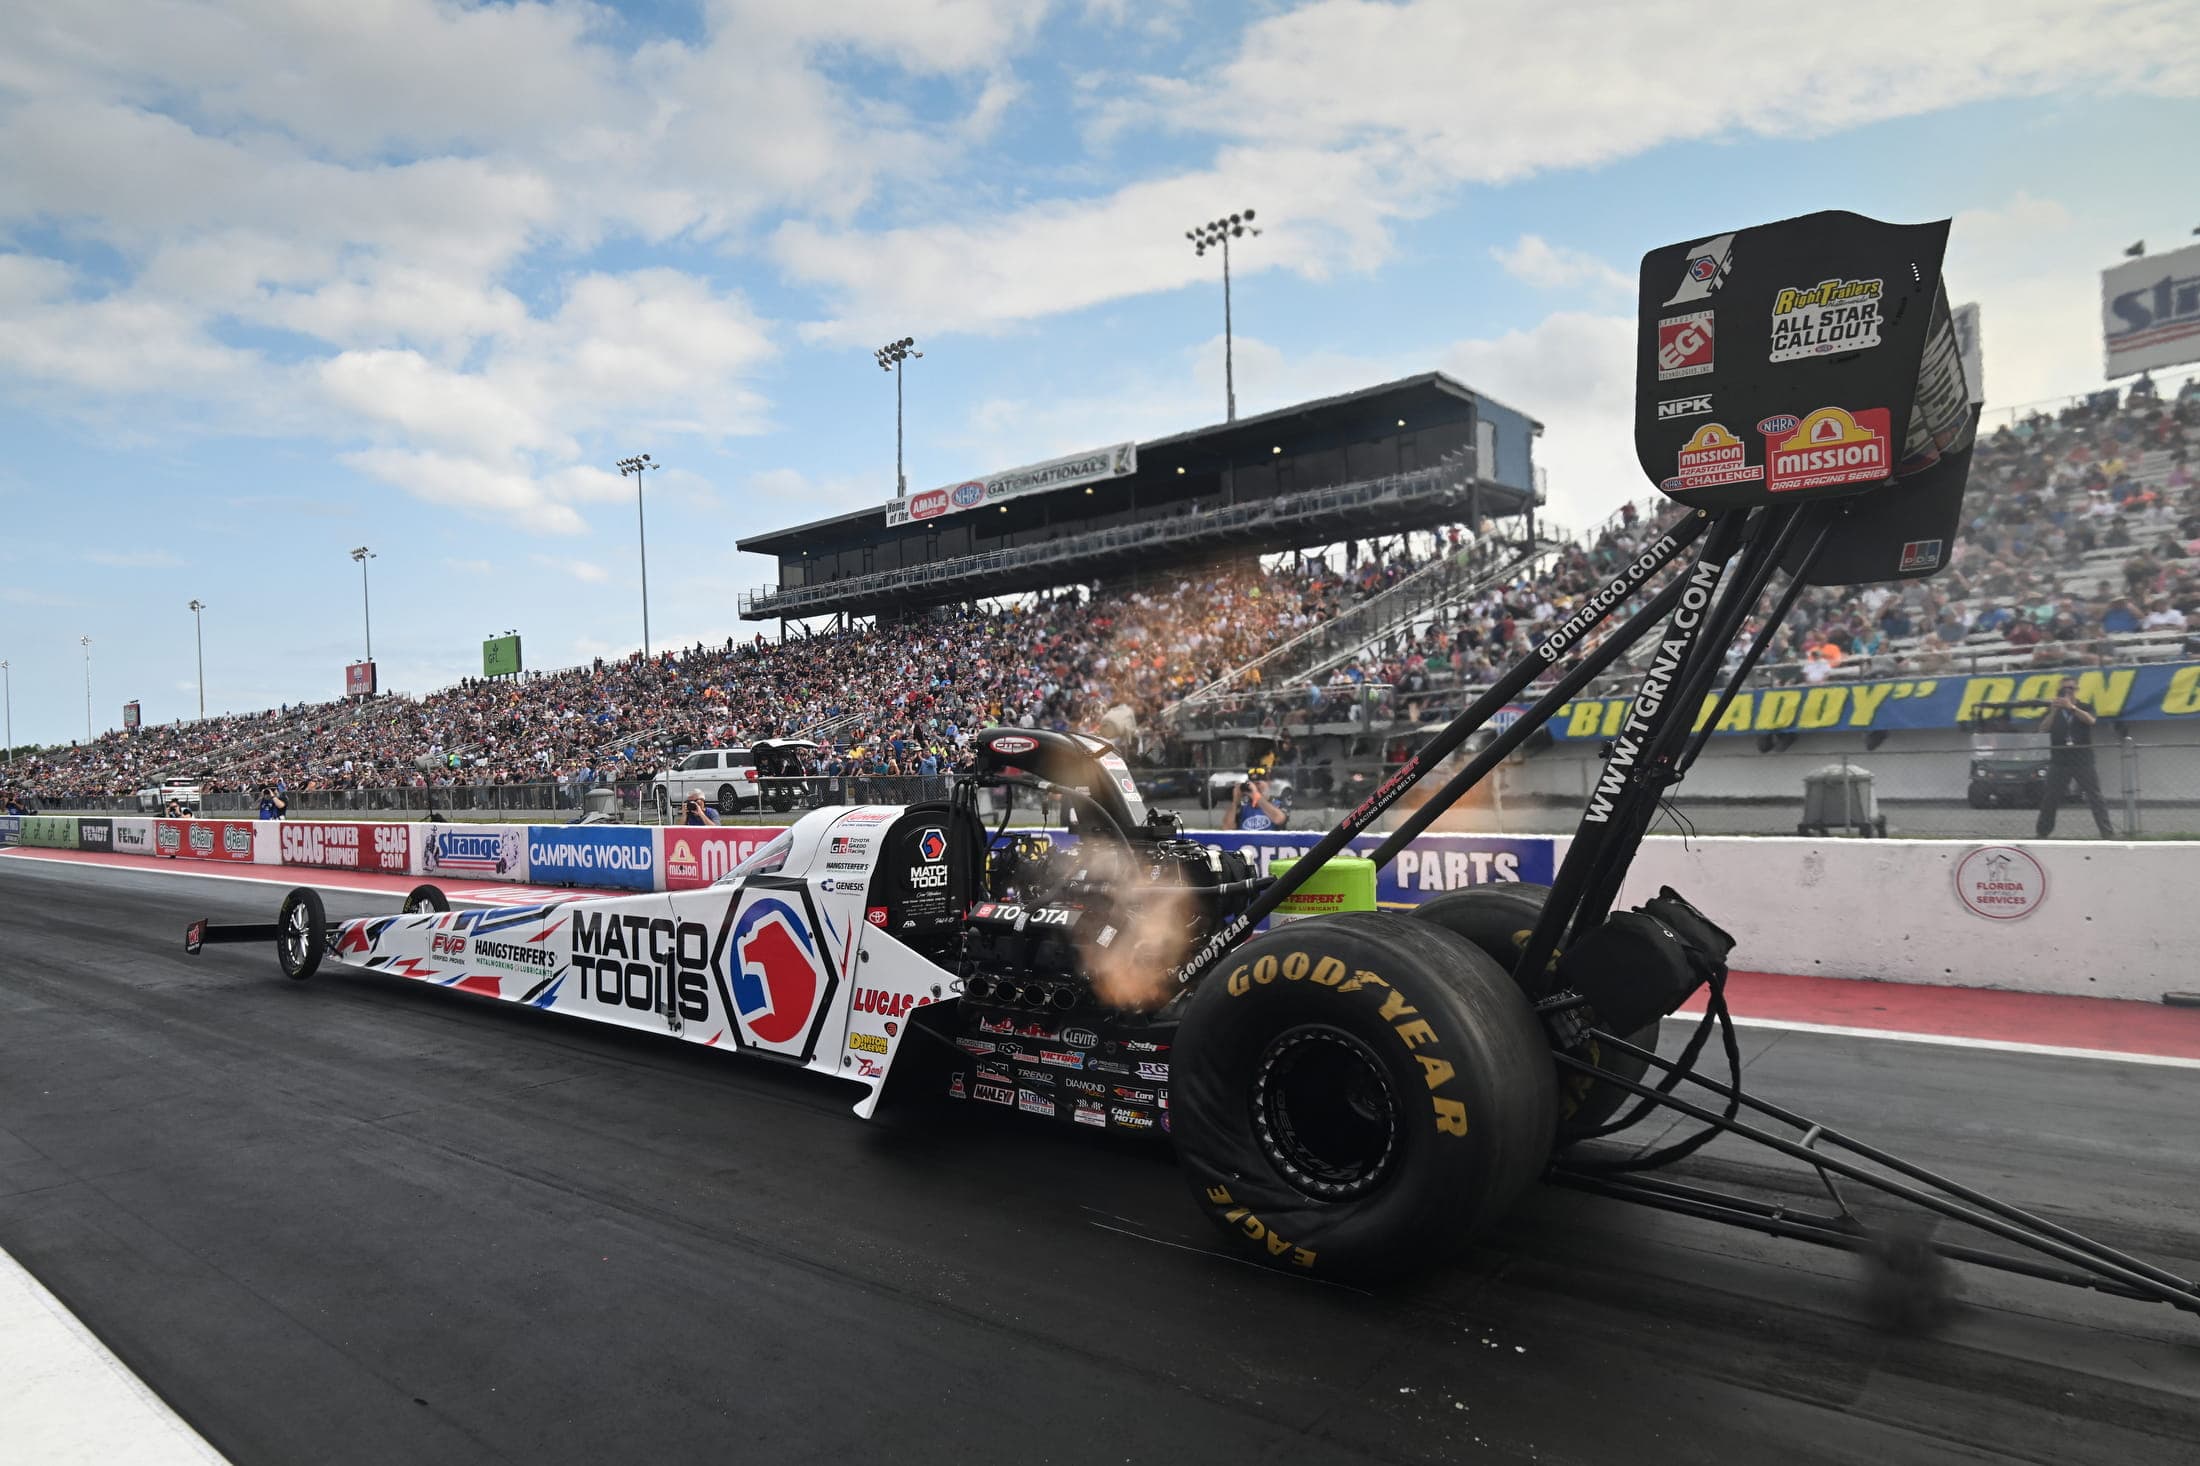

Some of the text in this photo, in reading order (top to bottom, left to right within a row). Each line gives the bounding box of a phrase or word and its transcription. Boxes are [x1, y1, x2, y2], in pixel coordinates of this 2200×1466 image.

[1774, 303, 1877, 335] ALL STAR
[1659, 318, 1713, 371] EGT
[1773, 320, 1876, 351] CALLOUT
[1658, 396, 1713, 417] NPK
[1763, 417, 1794, 433] NHRA
[1686, 469, 1760, 487] CHALLENGE
[1771, 468, 1889, 491] DRAG RACING SERIES
[887, 501, 906, 514] Home
[889, 510, 909, 524] of the
[1538, 534, 1678, 663] gomatco.com
[1584, 561, 1721, 824] WWW.TGRNA.COM
[1354, 772, 1417, 829] RACING DRIVE BELTS
[82, 825, 109, 843] FENDT
[282, 825, 325, 864] SCAG
[325, 826, 359, 846] POWER
[374, 826, 407, 853] SCAG
[438, 829, 501, 861] Strange
[831, 843, 848, 854] GR
[325, 847, 359, 867] EQUIPMENT
[529, 842, 652, 871] CAMPING WORLD
[826, 862, 870, 871] HANGSTERFER'S
[910, 865, 948, 878] MATC
[1396, 849, 1521, 891] PARTS
[836, 881, 865, 892] GENESIS
[910, 875, 948, 889] TOOL
[1976, 882, 2024, 891] FLORIDA
[1976, 895, 2027, 905] SERVICES
[994, 903, 1070, 926] TOOTA
[431, 932, 467, 956] FVP
[572, 909, 708, 971] MATCO
[1178, 914, 1251, 984] GOODYEAR
[475, 939, 556, 968] HANGSTERFER'S
[476, 958, 553, 978] METALWORKING LUBRICANTS
[571, 953, 709, 1023] TOOLS
[853, 987, 914, 1018] LUCAS
[1061, 1027, 1098, 1047] CLEVITE
[1227, 951, 1469, 1139] GOODYEAR
[1040, 1050, 1081, 1065] VICTORY
[1017, 1068, 1055, 1082] TREND
[1065, 1078, 1106, 1093] DIAMOND
[975, 1084, 1014, 1105] MANLEY
[1114, 1114, 1153, 1127] MOTION
